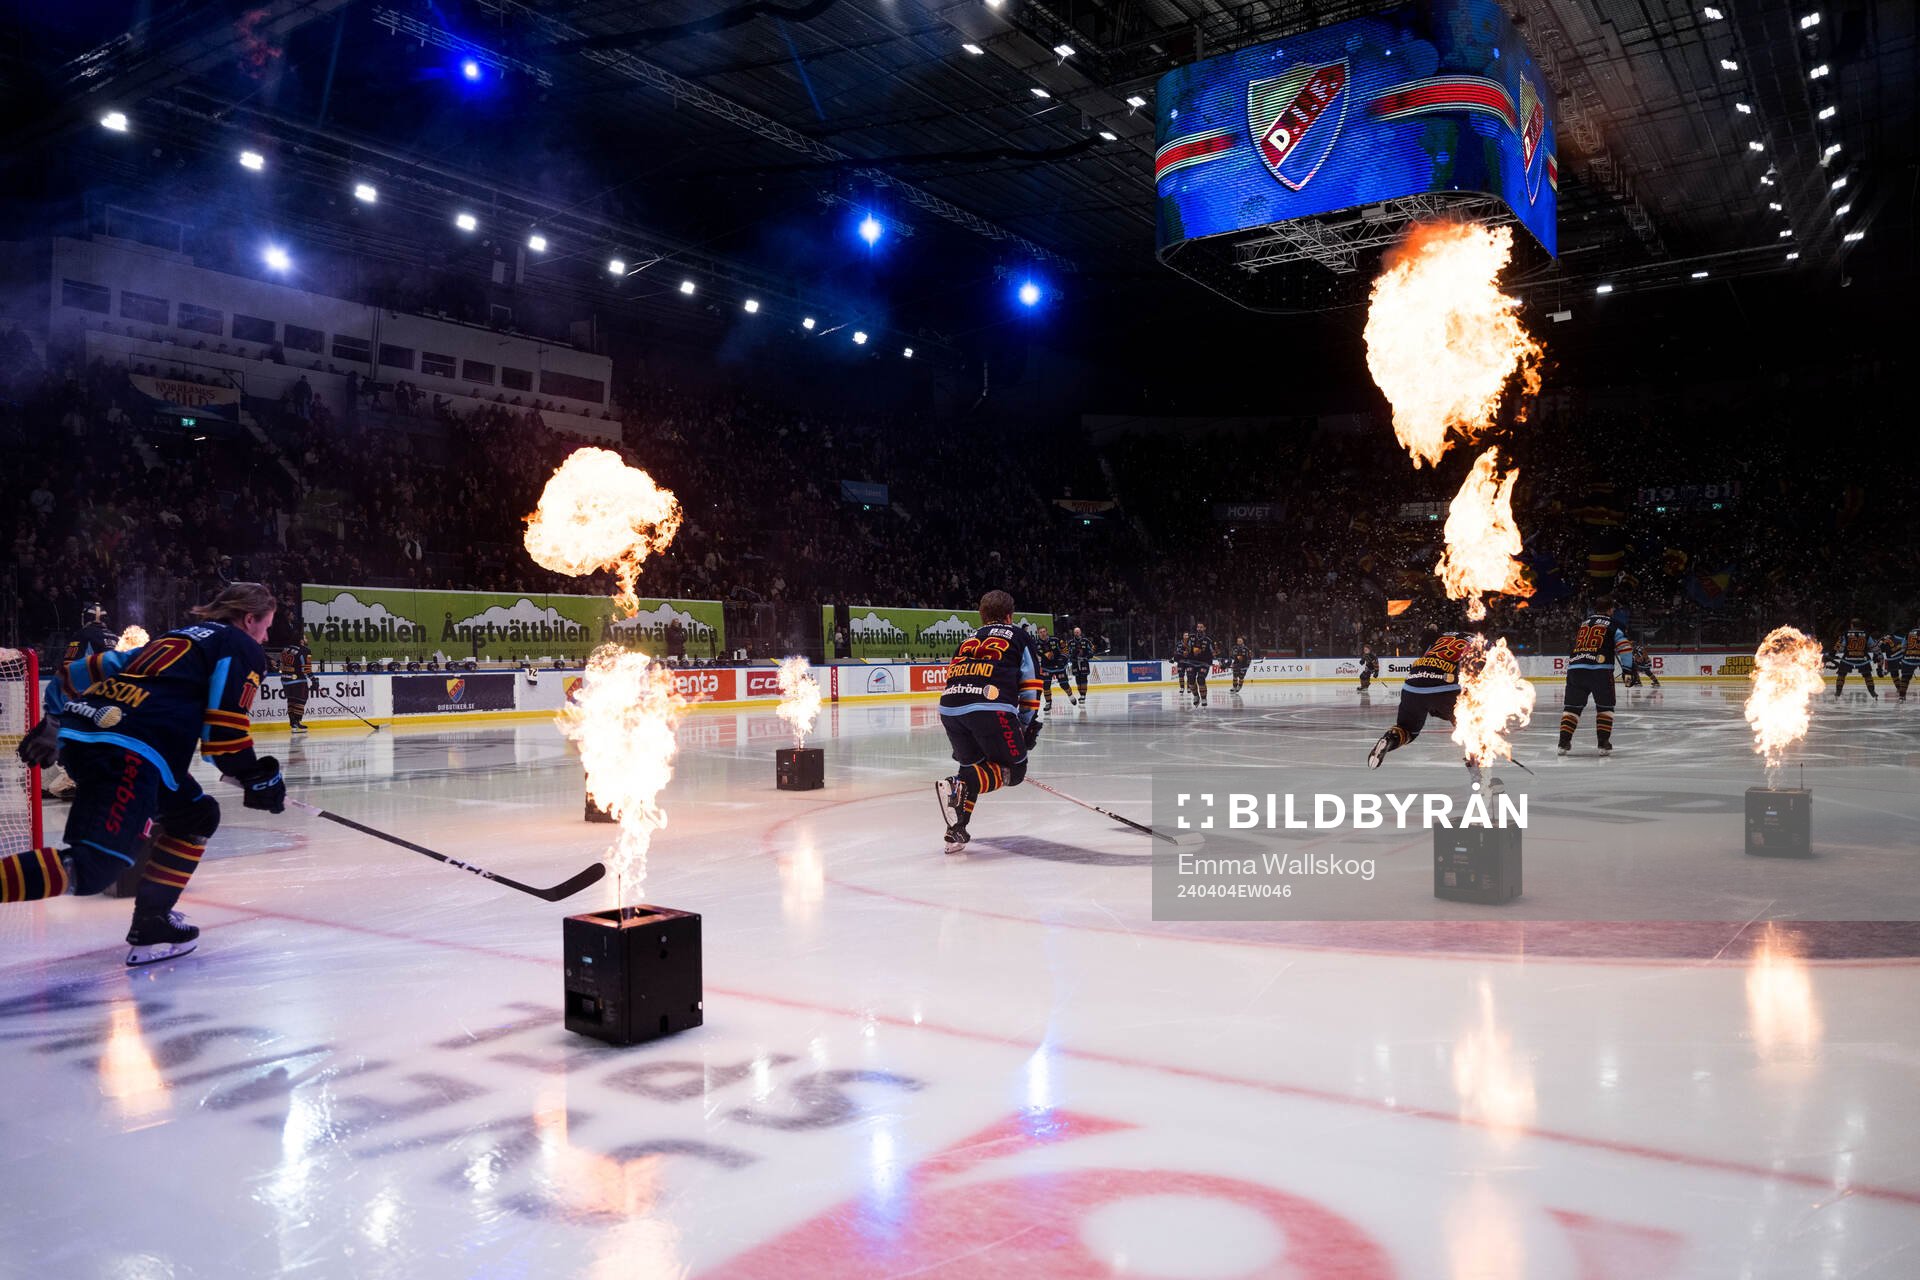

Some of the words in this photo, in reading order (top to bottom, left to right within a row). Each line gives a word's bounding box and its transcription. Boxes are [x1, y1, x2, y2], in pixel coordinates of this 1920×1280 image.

[155, 382, 216, 400] NORRLANDS
[164, 391, 209, 408] GULD
[1226, 506, 1271, 517] HOVET
[441, 612, 590, 648] Ångtvättbilen
[600, 614, 718, 647] Ångtväbilen
[922, 667, 947, 684] rent
[1253, 665, 1303, 673] FASTATO
[1717, 665, 1752, 675] JACKP
[261, 683, 330, 700] Broa
[336, 680, 365, 698] Stål
[750, 677, 780, 690] CC
[257, 707, 275, 718] STÅL
[318, 703, 367, 715] STOCKHOLM
